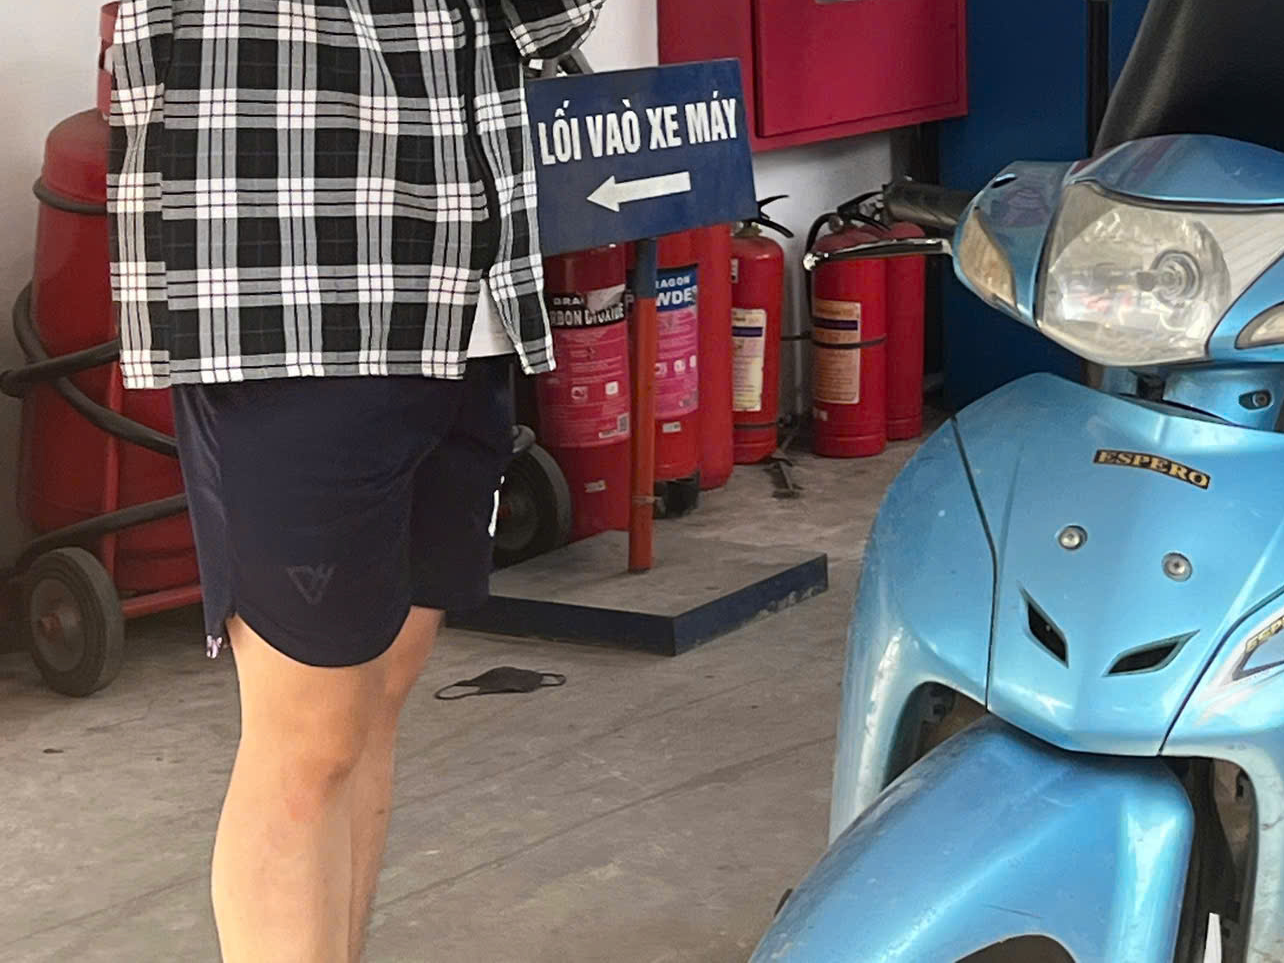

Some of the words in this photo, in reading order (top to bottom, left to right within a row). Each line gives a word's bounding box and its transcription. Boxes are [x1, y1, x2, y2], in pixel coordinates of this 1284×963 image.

[538, 100, 582, 166] LỐI
[646, 105, 682, 150] XE
[684, 90, 737, 145] MÁY
[1098, 450, 1209, 487] ESPERO
